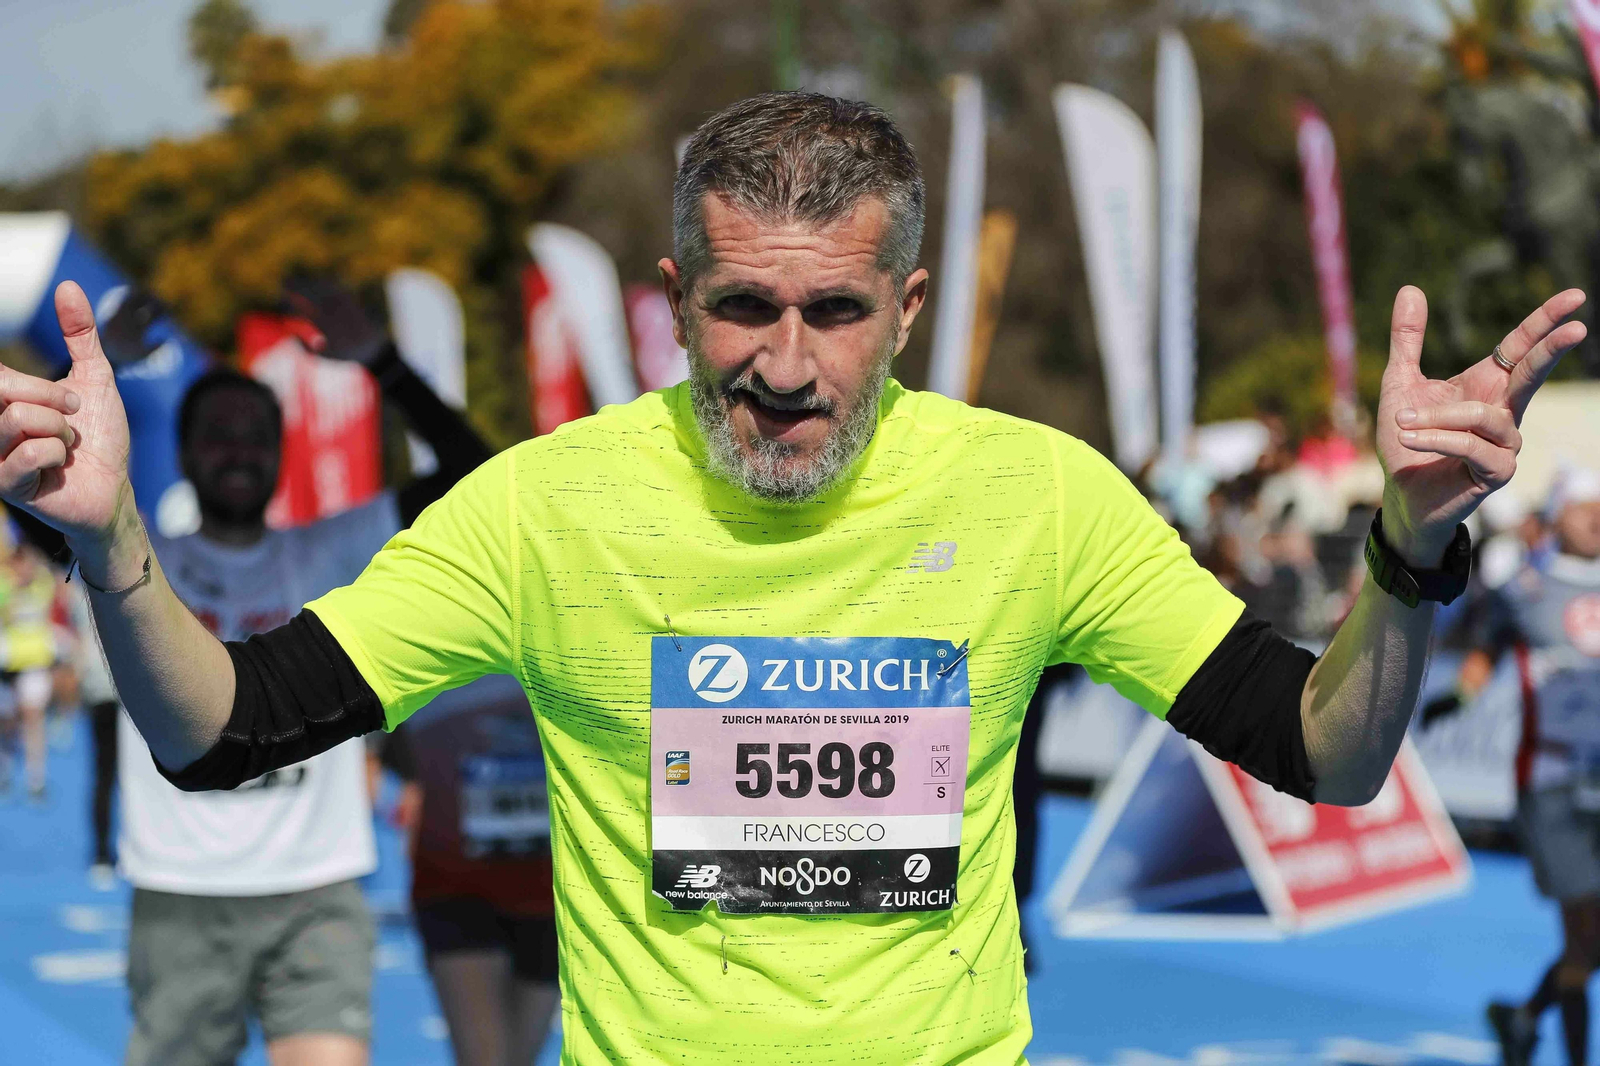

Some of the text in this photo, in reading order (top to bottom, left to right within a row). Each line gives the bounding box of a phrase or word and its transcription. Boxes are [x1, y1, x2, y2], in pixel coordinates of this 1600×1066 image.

[760, 658, 931, 692] ZURICH
[721, 712, 911, 725] ZURICH MARATÓN DE SEVILLA 2019
[931, 744, 951, 752] ELITE
[735, 741, 896, 799] 5598
[936, 786, 946, 799] S
[743, 823, 886, 843] FRANCESCO
[665, 890, 729, 900] new balance
[879, 888, 951, 907] ZURICH
